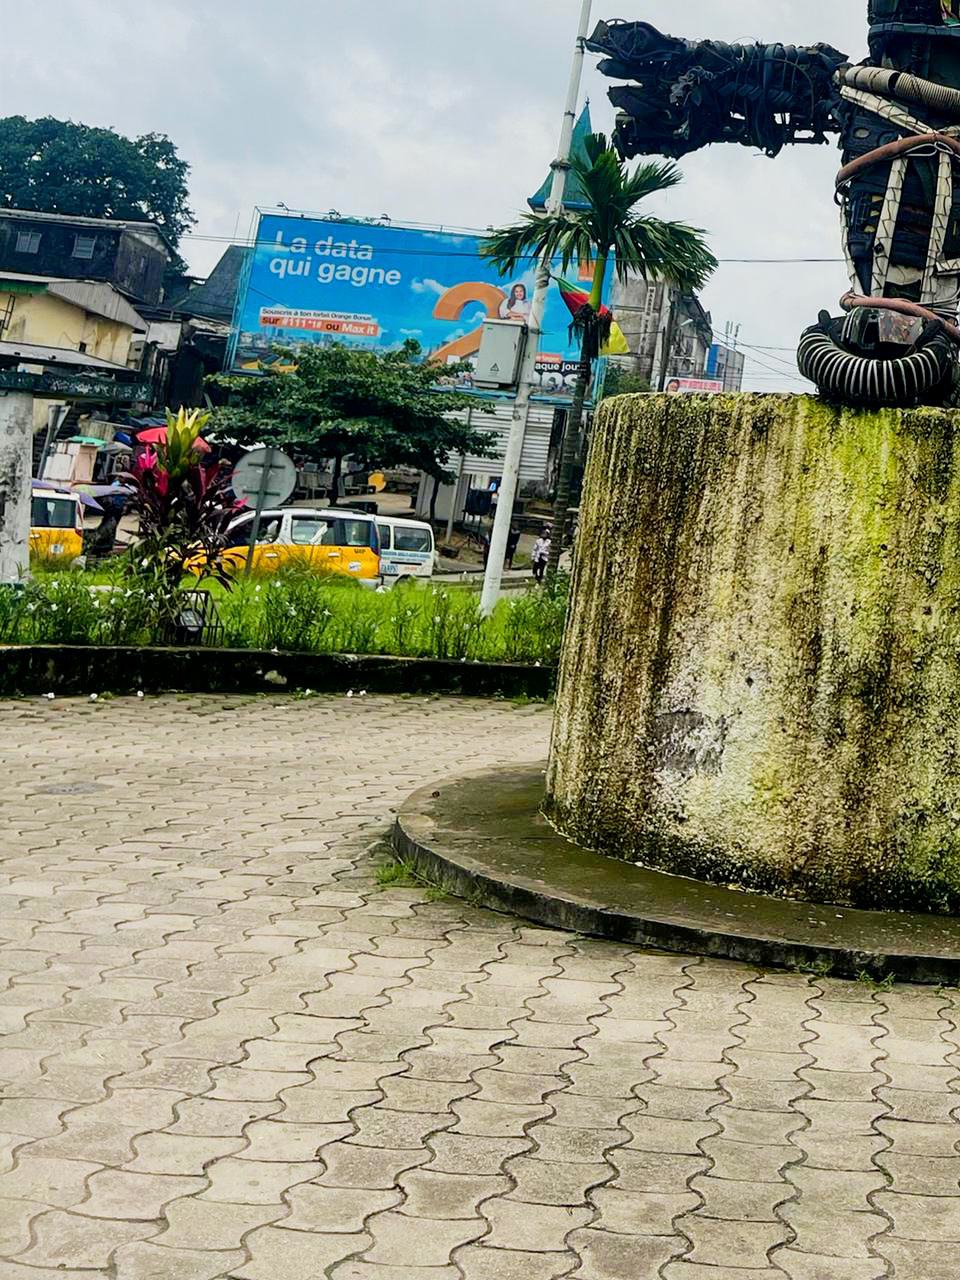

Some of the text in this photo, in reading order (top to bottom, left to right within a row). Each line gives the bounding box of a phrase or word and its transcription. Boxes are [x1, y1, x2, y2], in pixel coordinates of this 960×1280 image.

[273, 230, 373, 260] La data
[269, 256, 401, 287] qui gagne
[262, 316, 280, 325] sur
[326, 323, 340, 332] ou
[342, 323, 365, 334] Max
[366, 323, 375, 335] it
[331, 312, 353, 321] Orange
